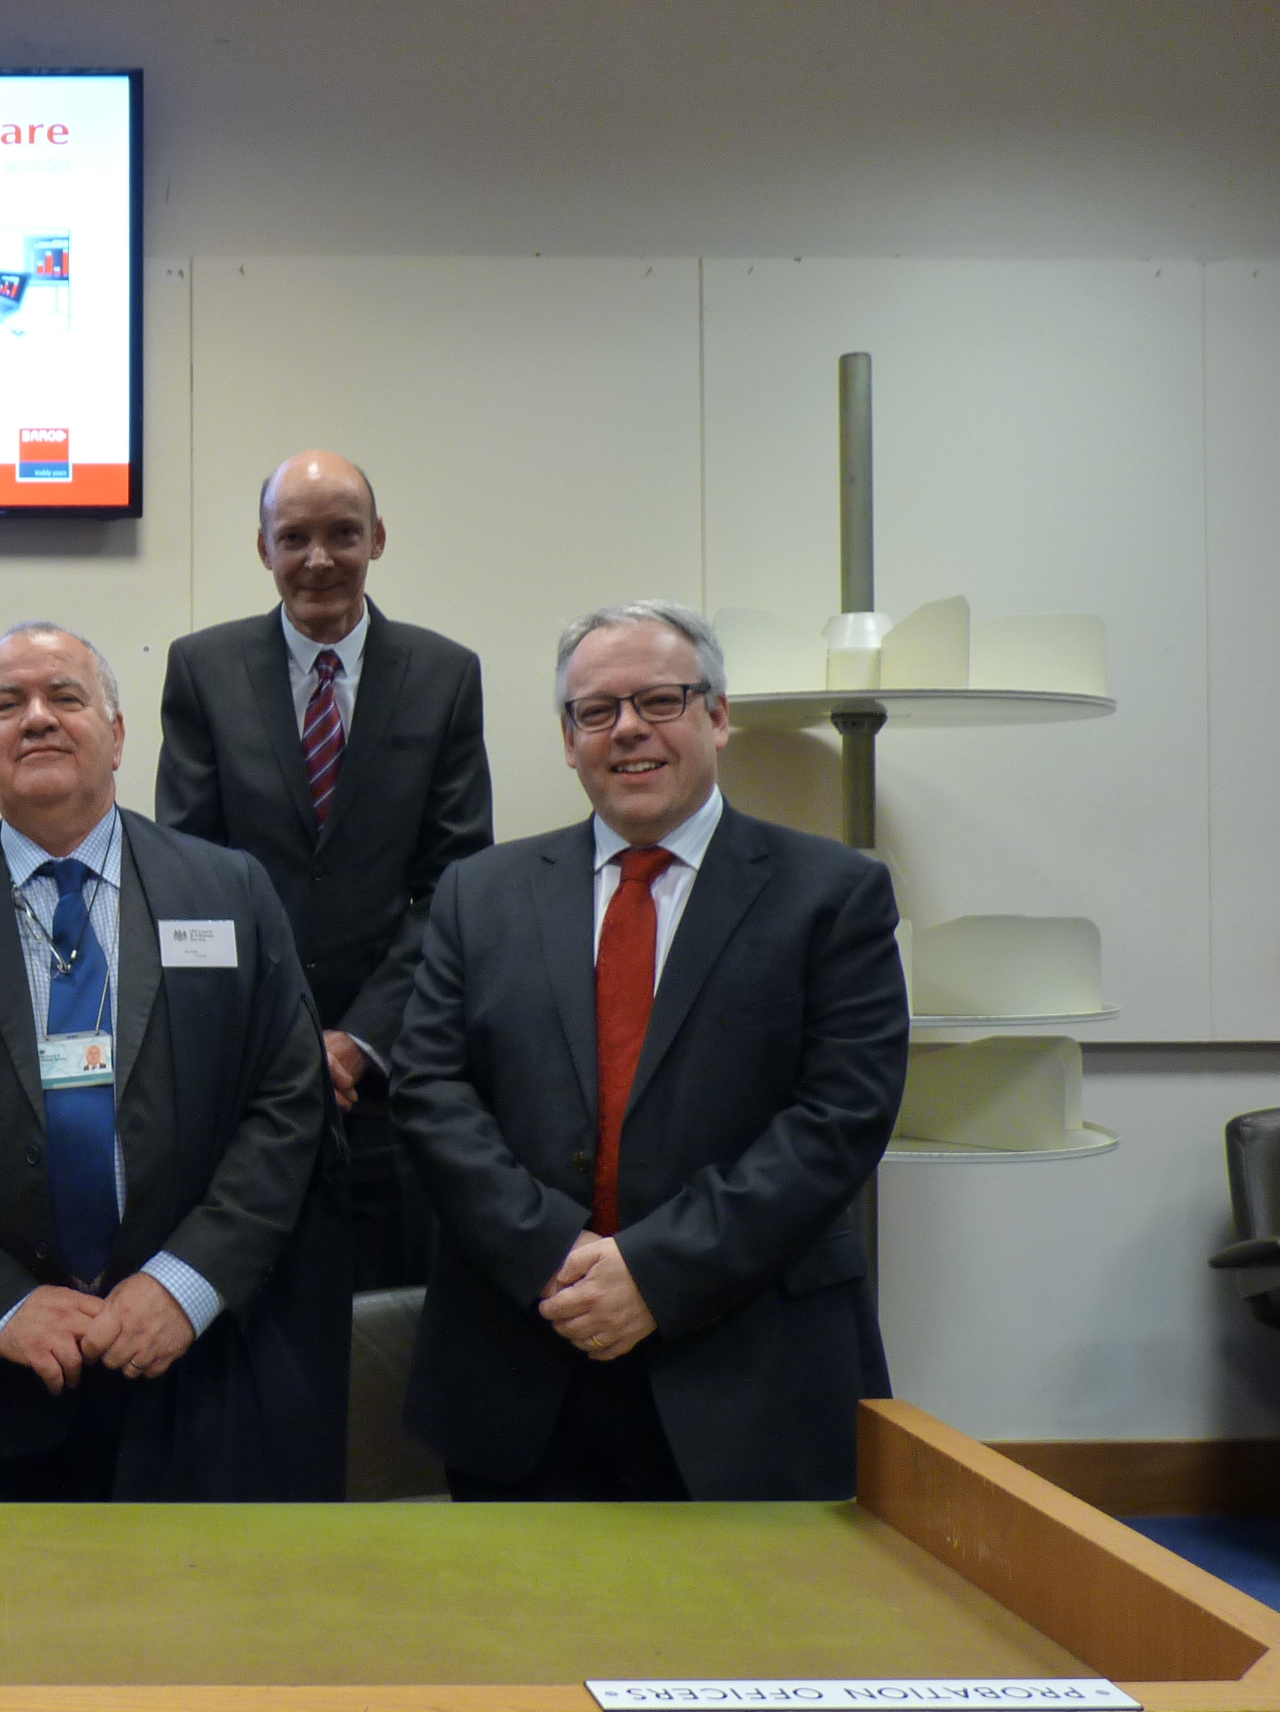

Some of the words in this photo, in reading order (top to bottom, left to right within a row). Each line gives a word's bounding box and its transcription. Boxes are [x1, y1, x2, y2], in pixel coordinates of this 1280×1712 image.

[21, 430, 67, 442] BARCO
[626, 1687, 824, 1700] OFFICERS
[843, 1686, 1087, 1700] PROBATION
